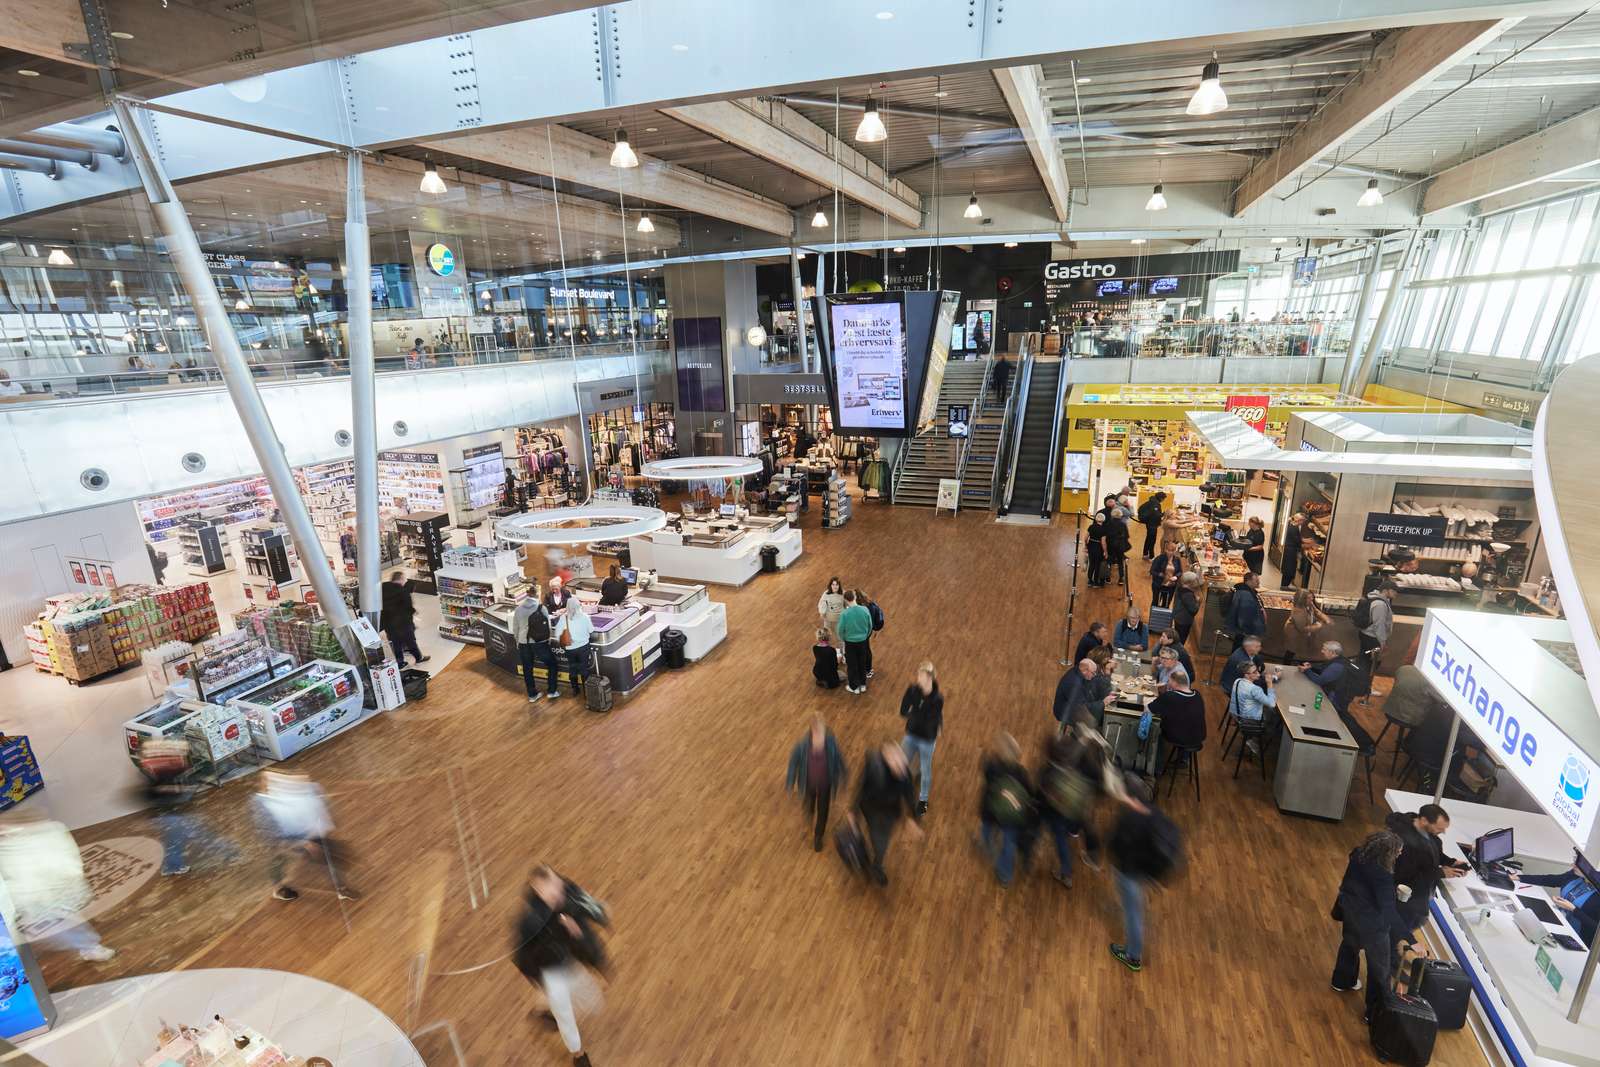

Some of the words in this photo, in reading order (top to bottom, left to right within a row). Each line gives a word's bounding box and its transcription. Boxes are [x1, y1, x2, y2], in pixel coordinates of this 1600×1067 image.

[207, 261, 232, 269] GERS
[216, 254, 246, 262] CLASS
[1044, 260, 1116, 280] Gastro
[549, 286, 578, 298] Sunset
[579, 288, 615, 300] Boulevard
[843, 318, 891, 328] Danmarks
[867, 328, 892, 337] læste
[783, 384, 826, 394] BESTSELL
[1230, 406, 1266, 422] LEGO
[1377, 524, 1404, 534] COFFEE
[1404, 525, 1421, 535] PICK
[1422, 528, 1433, 536] UP
[428, 521, 439, 560] TRAVEL
[1430, 634, 1538, 767] Exchange
[1552, 798, 1577, 828] Exchange
[1554, 791, 1580, 822] Global
